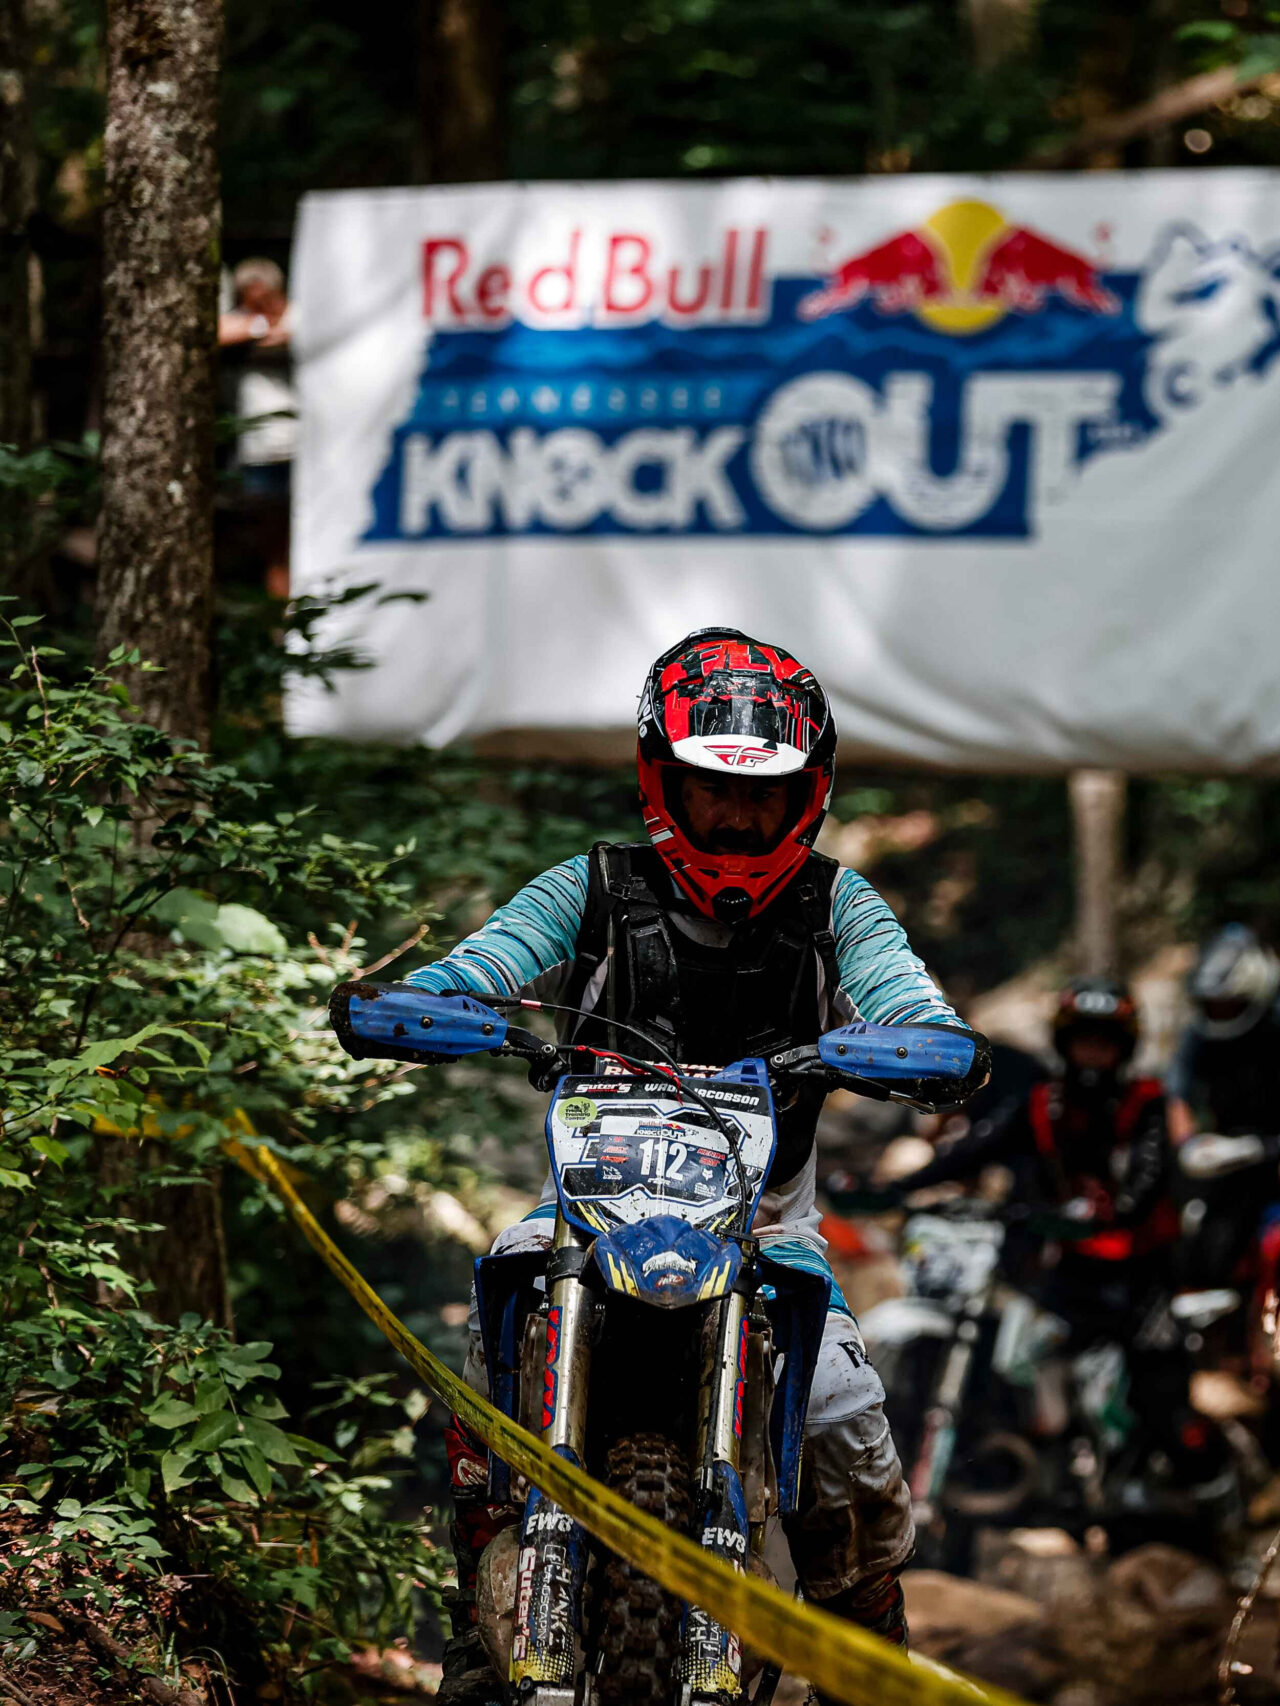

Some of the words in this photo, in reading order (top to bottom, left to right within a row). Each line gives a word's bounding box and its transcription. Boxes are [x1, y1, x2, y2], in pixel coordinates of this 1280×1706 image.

[420, 228, 583, 320] Red
[602, 228, 768, 318] Bull
[401, 427, 748, 535] KNOCK
[750, 369, 1121, 531] OUT
[639, 1138, 688, 1181] 112
